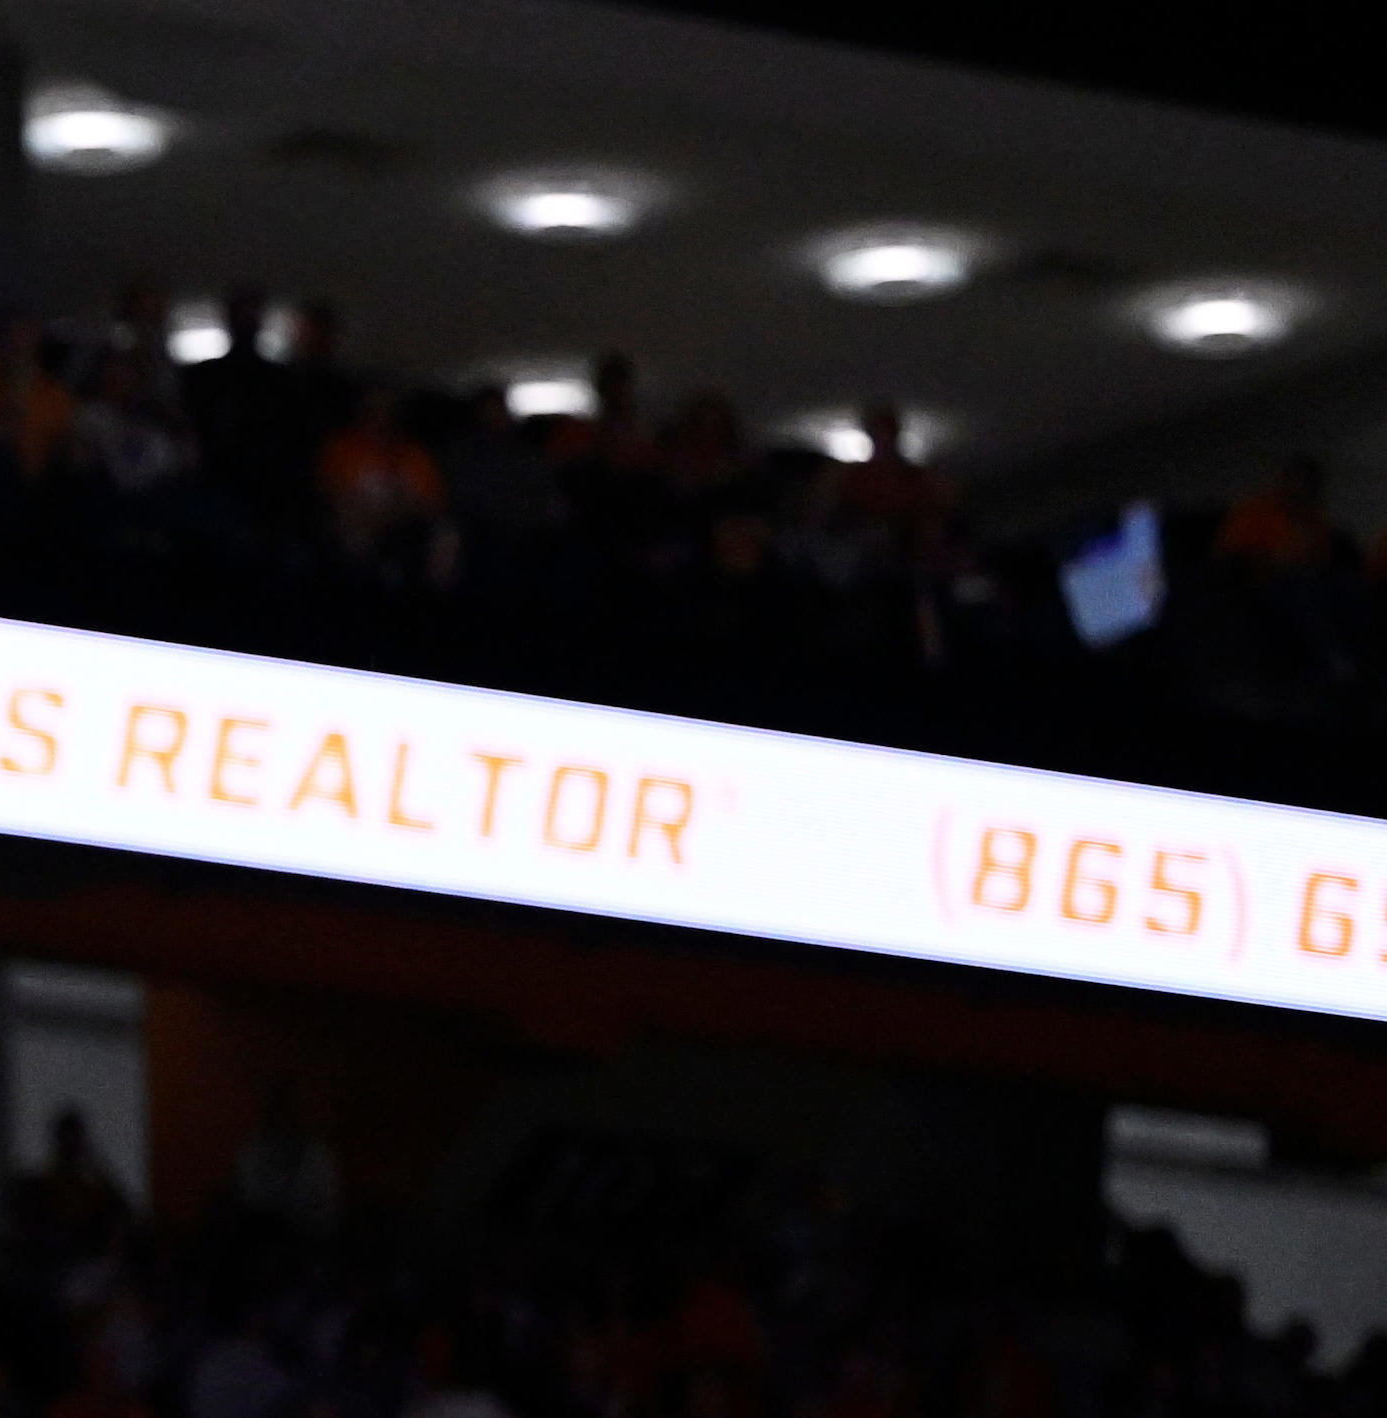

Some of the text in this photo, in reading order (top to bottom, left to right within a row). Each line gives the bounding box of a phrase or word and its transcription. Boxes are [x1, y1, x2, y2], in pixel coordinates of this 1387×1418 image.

[115, 701, 695, 865] REALTOR
[931, 803, 1248, 968] (865)
[1298, 871, 1387, 963] 6
